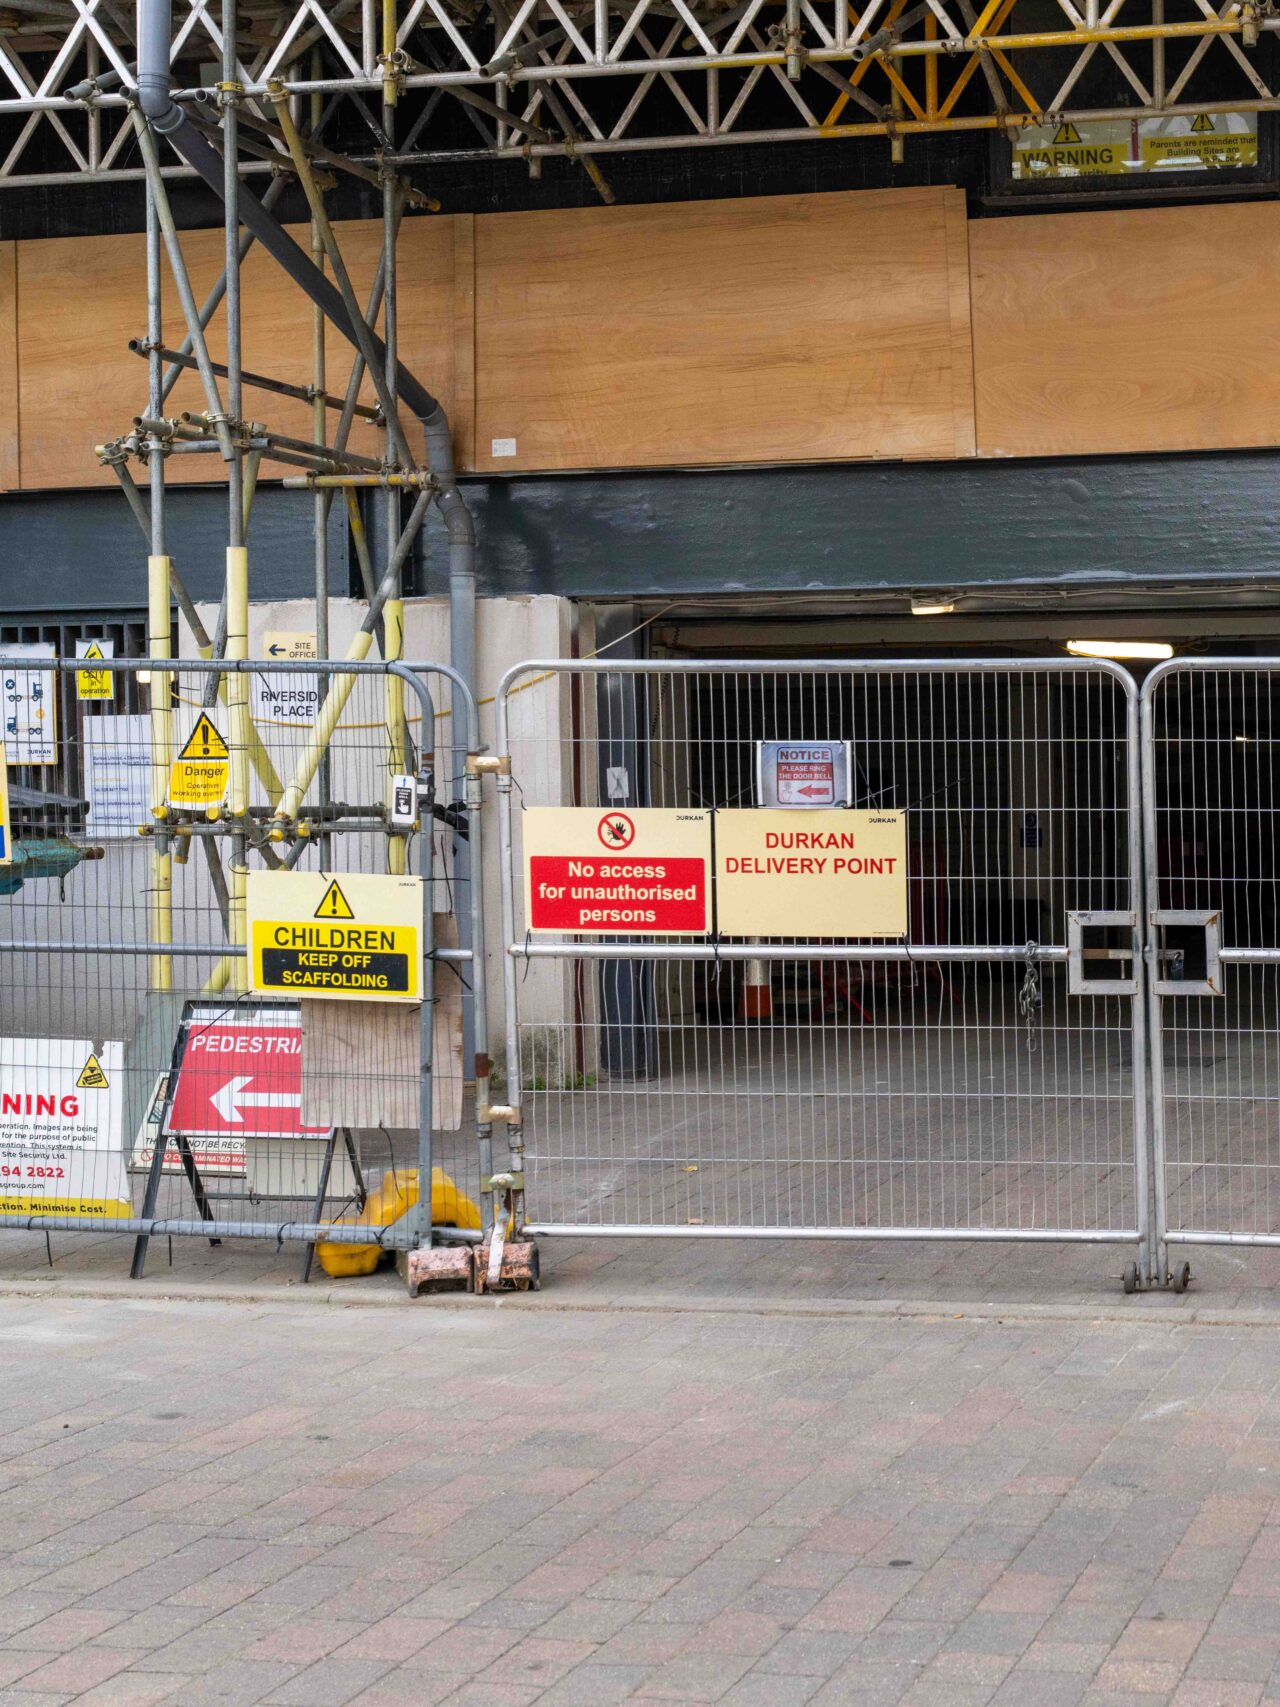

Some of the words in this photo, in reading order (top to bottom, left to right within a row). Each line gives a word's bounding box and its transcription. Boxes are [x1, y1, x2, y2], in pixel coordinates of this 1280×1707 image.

[1150, 141, 1182, 149] Parents
[1200, 137, 1238, 146] reminded
[1022, 148, 1113, 168] WARNING
[1167, 148, 1201, 157] Building
[1203, 147, 1224, 155] Sites
[294, 642, 311, 650] SITE
[289, 651, 317, 659] OFFICE
[80, 687, 110, 695] operation
[261, 691, 318, 702] RIVERSID
[273, 705, 313, 717] PLACE
[780, 751, 829, 760] NOTICE
[185, 766, 224, 778] Danger
[172, 790, 201, 798] working
[765, 832, 855, 849] DURKAN
[568, 861, 594, 877] No
[600, 864, 666, 878] access
[725, 857, 827, 874] DELIVERY
[833, 858, 897, 874] POINT
[539, 883, 566, 899] for
[571, 884, 697, 900] unauthorised
[579, 909, 656, 925] persons
[274, 926, 395, 950] CHILDREN
[298, 953, 338, 967] KEEP
[341, 954, 371, 968] OFF
[282, 970, 388, 988] SCAFFOLDING
[2, 1093, 79, 1117] NING
[33, 1124, 60, 1132] Images
[76, 1125, 98, 1133] being
[29, 1134, 60, 1142] purpose
[207, 1140, 220, 1148] BE
[18, 1151, 50, 1160] Security
[0, 1166, 21, 1177] 94
[26, 1166, 65, 1178] 2822
[30, 1203, 76, 1212] Minimise
[80, 1205, 107, 1213] Cost.
